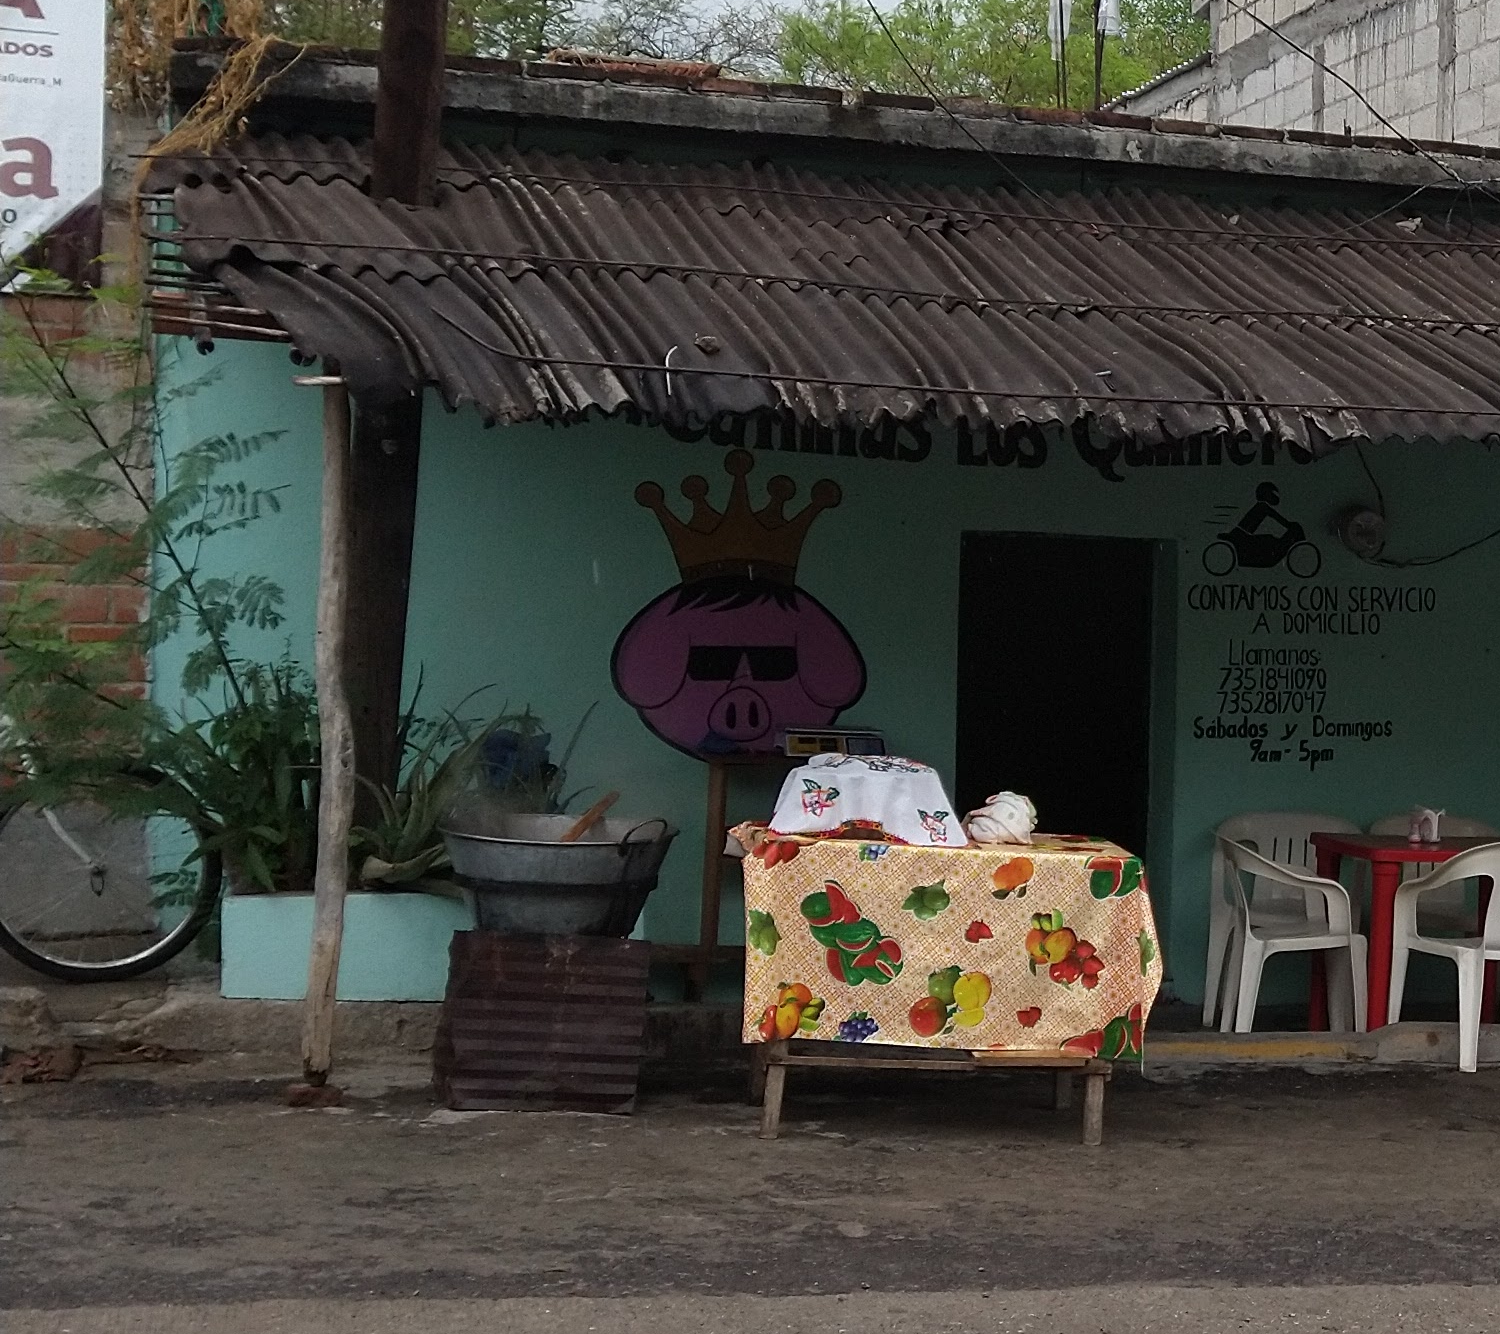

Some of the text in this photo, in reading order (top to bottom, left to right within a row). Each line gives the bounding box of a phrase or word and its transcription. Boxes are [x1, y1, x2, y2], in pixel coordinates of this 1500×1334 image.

[0, 41, 54, 58] DOS
[1187, 584, 1436, 612] CONTAMOS CON SERVICIO
[1252, 613, 1381, 635] A DOMICILIO
[1219, 668, 1327, 690] 7351841090
[1216, 691, 1327, 714] 7352817047
[1193, 716, 1393, 741] Sábados y Domingos
